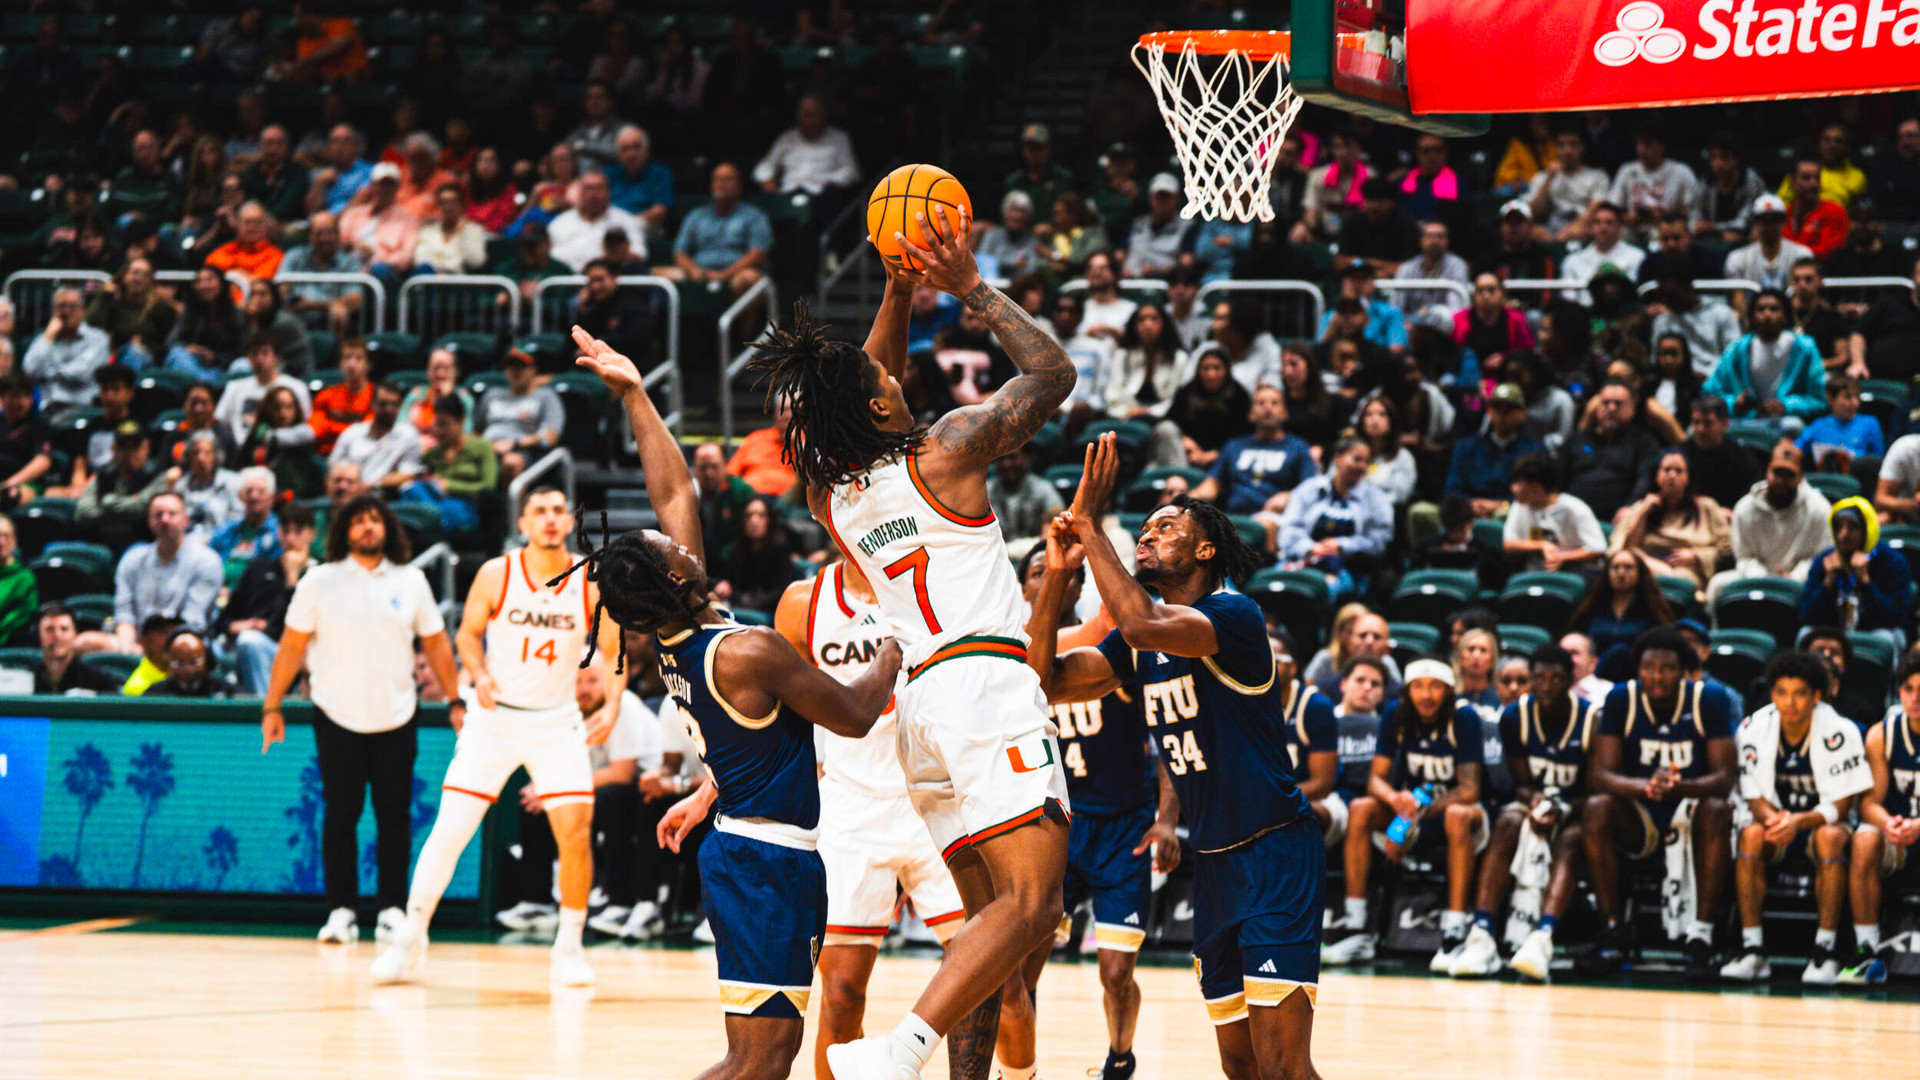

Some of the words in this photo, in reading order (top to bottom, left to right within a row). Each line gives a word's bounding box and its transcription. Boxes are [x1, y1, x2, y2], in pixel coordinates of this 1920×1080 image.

[857, 516, 918, 559] HENDERSON
[883, 545, 943, 636] 7
[508, 608, 576, 631] CANES
[521, 636, 558, 667] 14
[820, 635, 895, 667] CAN
[1143, 674, 1199, 727] FIU
[1162, 730, 1208, 776] 34
[1407, 752, 1454, 781] FIU
[1639, 738, 1693, 769] FIU
[1528, 756, 1578, 787] FIU
